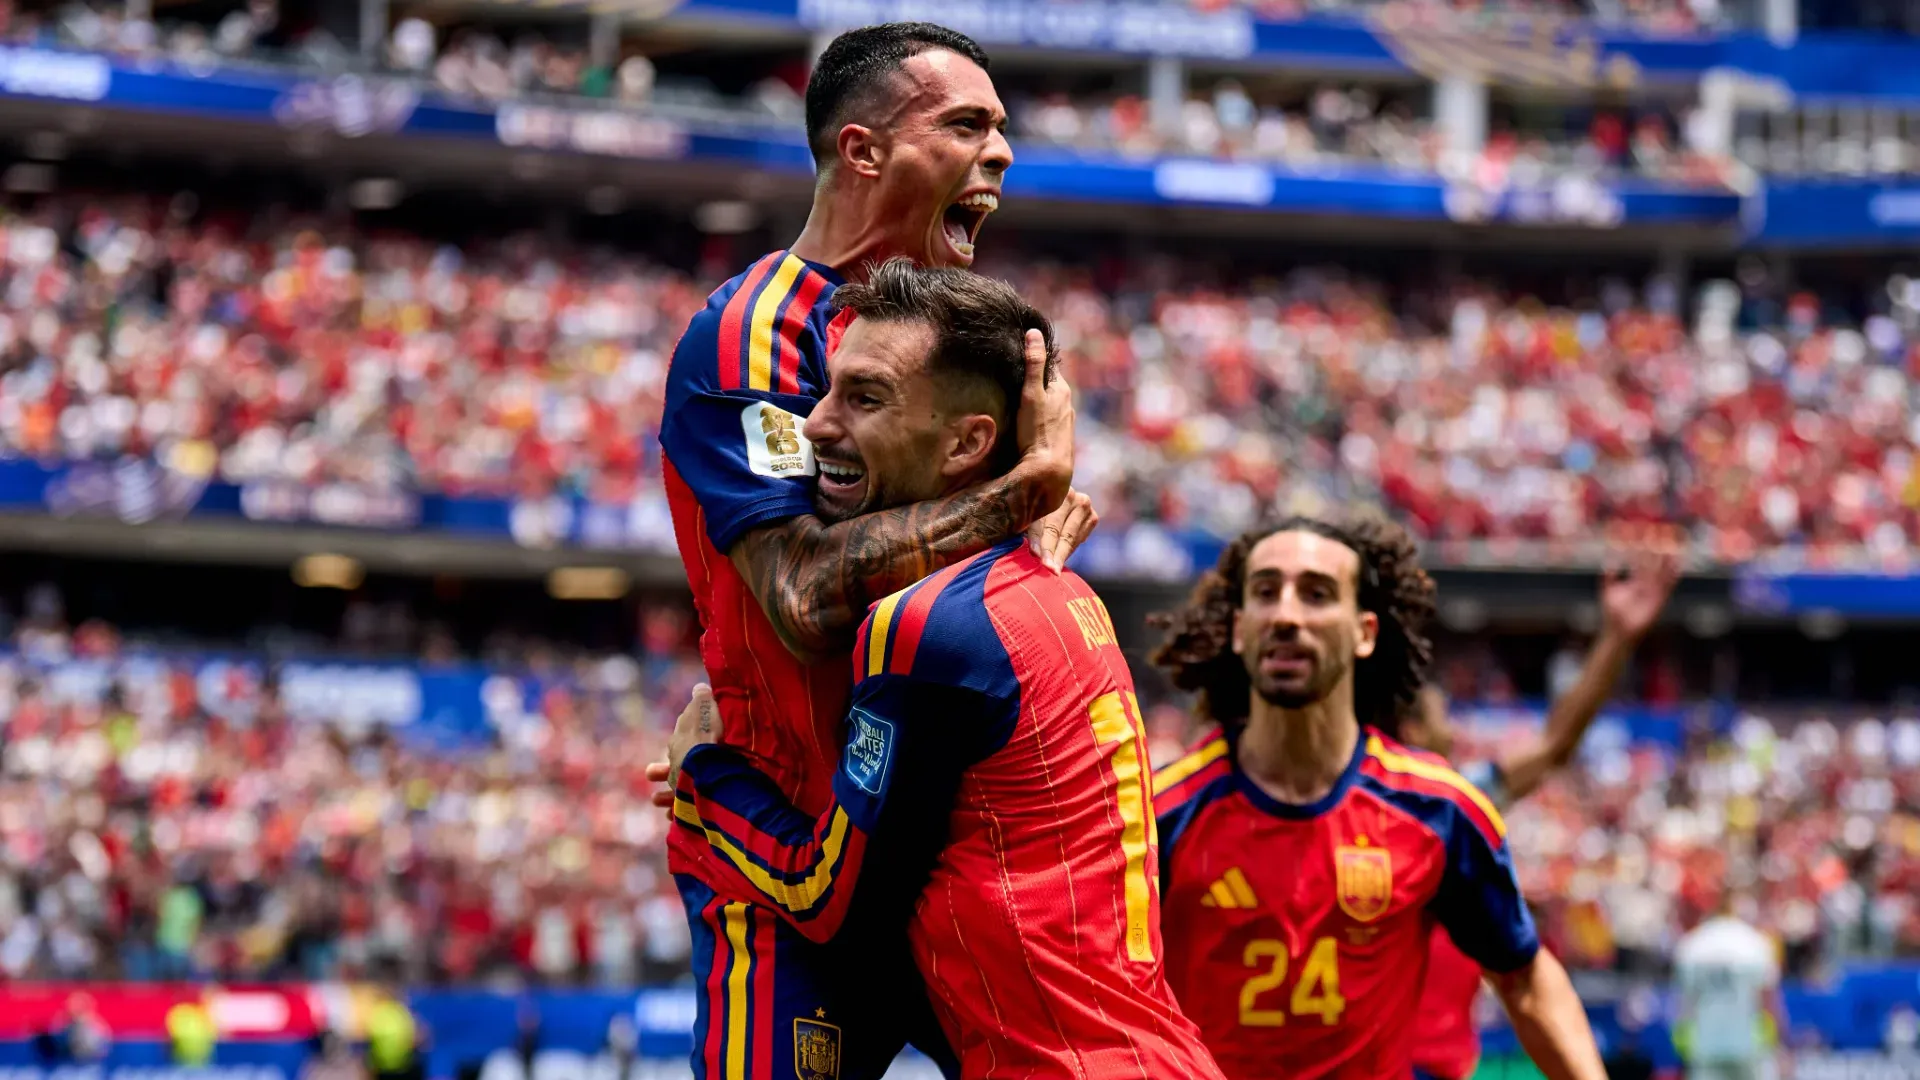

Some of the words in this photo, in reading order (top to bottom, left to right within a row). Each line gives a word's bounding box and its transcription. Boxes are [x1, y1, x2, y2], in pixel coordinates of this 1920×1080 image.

[770, 461, 804, 472] 2026
[859, 762, 871, 777] FIFA
[1239, 936, 1346, 1027] 24
